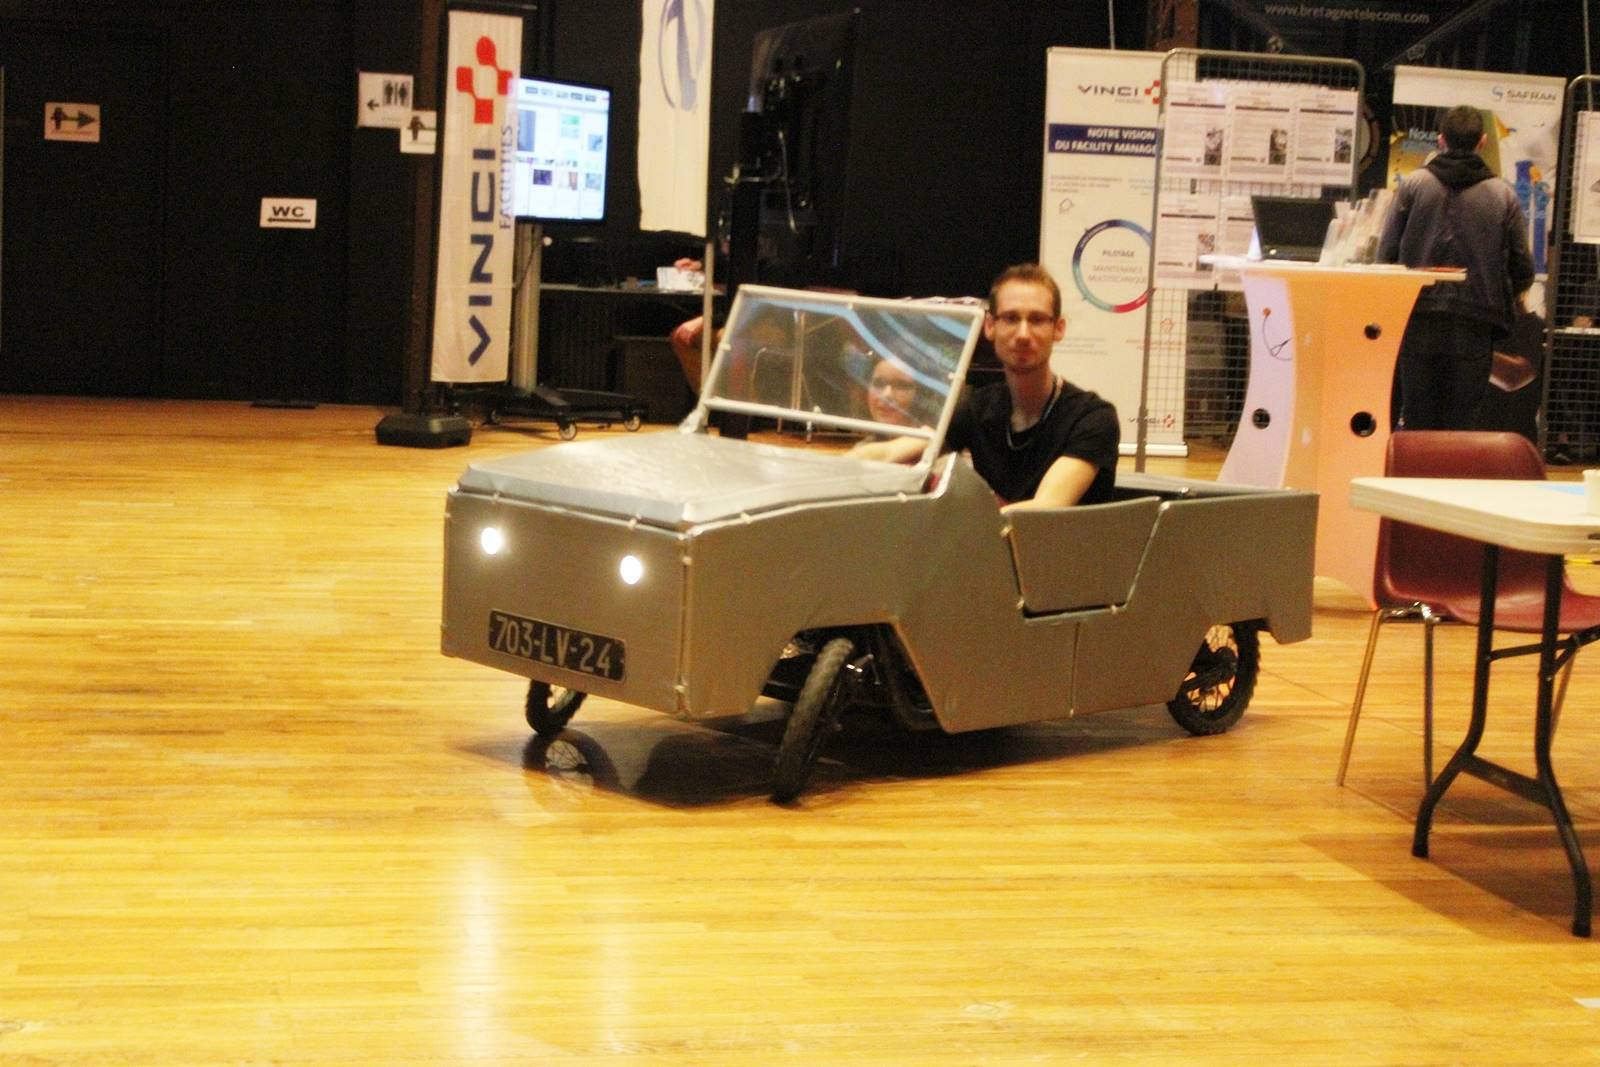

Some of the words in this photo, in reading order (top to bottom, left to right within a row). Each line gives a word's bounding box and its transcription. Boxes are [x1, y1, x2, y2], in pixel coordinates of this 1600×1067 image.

[1264, 4, 1430, 24] www.bretagnetelecom.com
[1078, 84, 1138, 97] VINCI
[1507, 89, 1557, 101] SAFRAN
[1087, 127, 1120, 139] NOTRE
[1121, 129, 1155, 141] VISION
[1054, 139, 1070, 151] DU
[1071, 140, 1113, 153] FACILITY
[499, 125, 512, 229] FACILITIES
[272, 206, 304, 217] WC
[467, 148, 497, 367] VINCI
[494, 614, 613, 677] 703-LV-24
